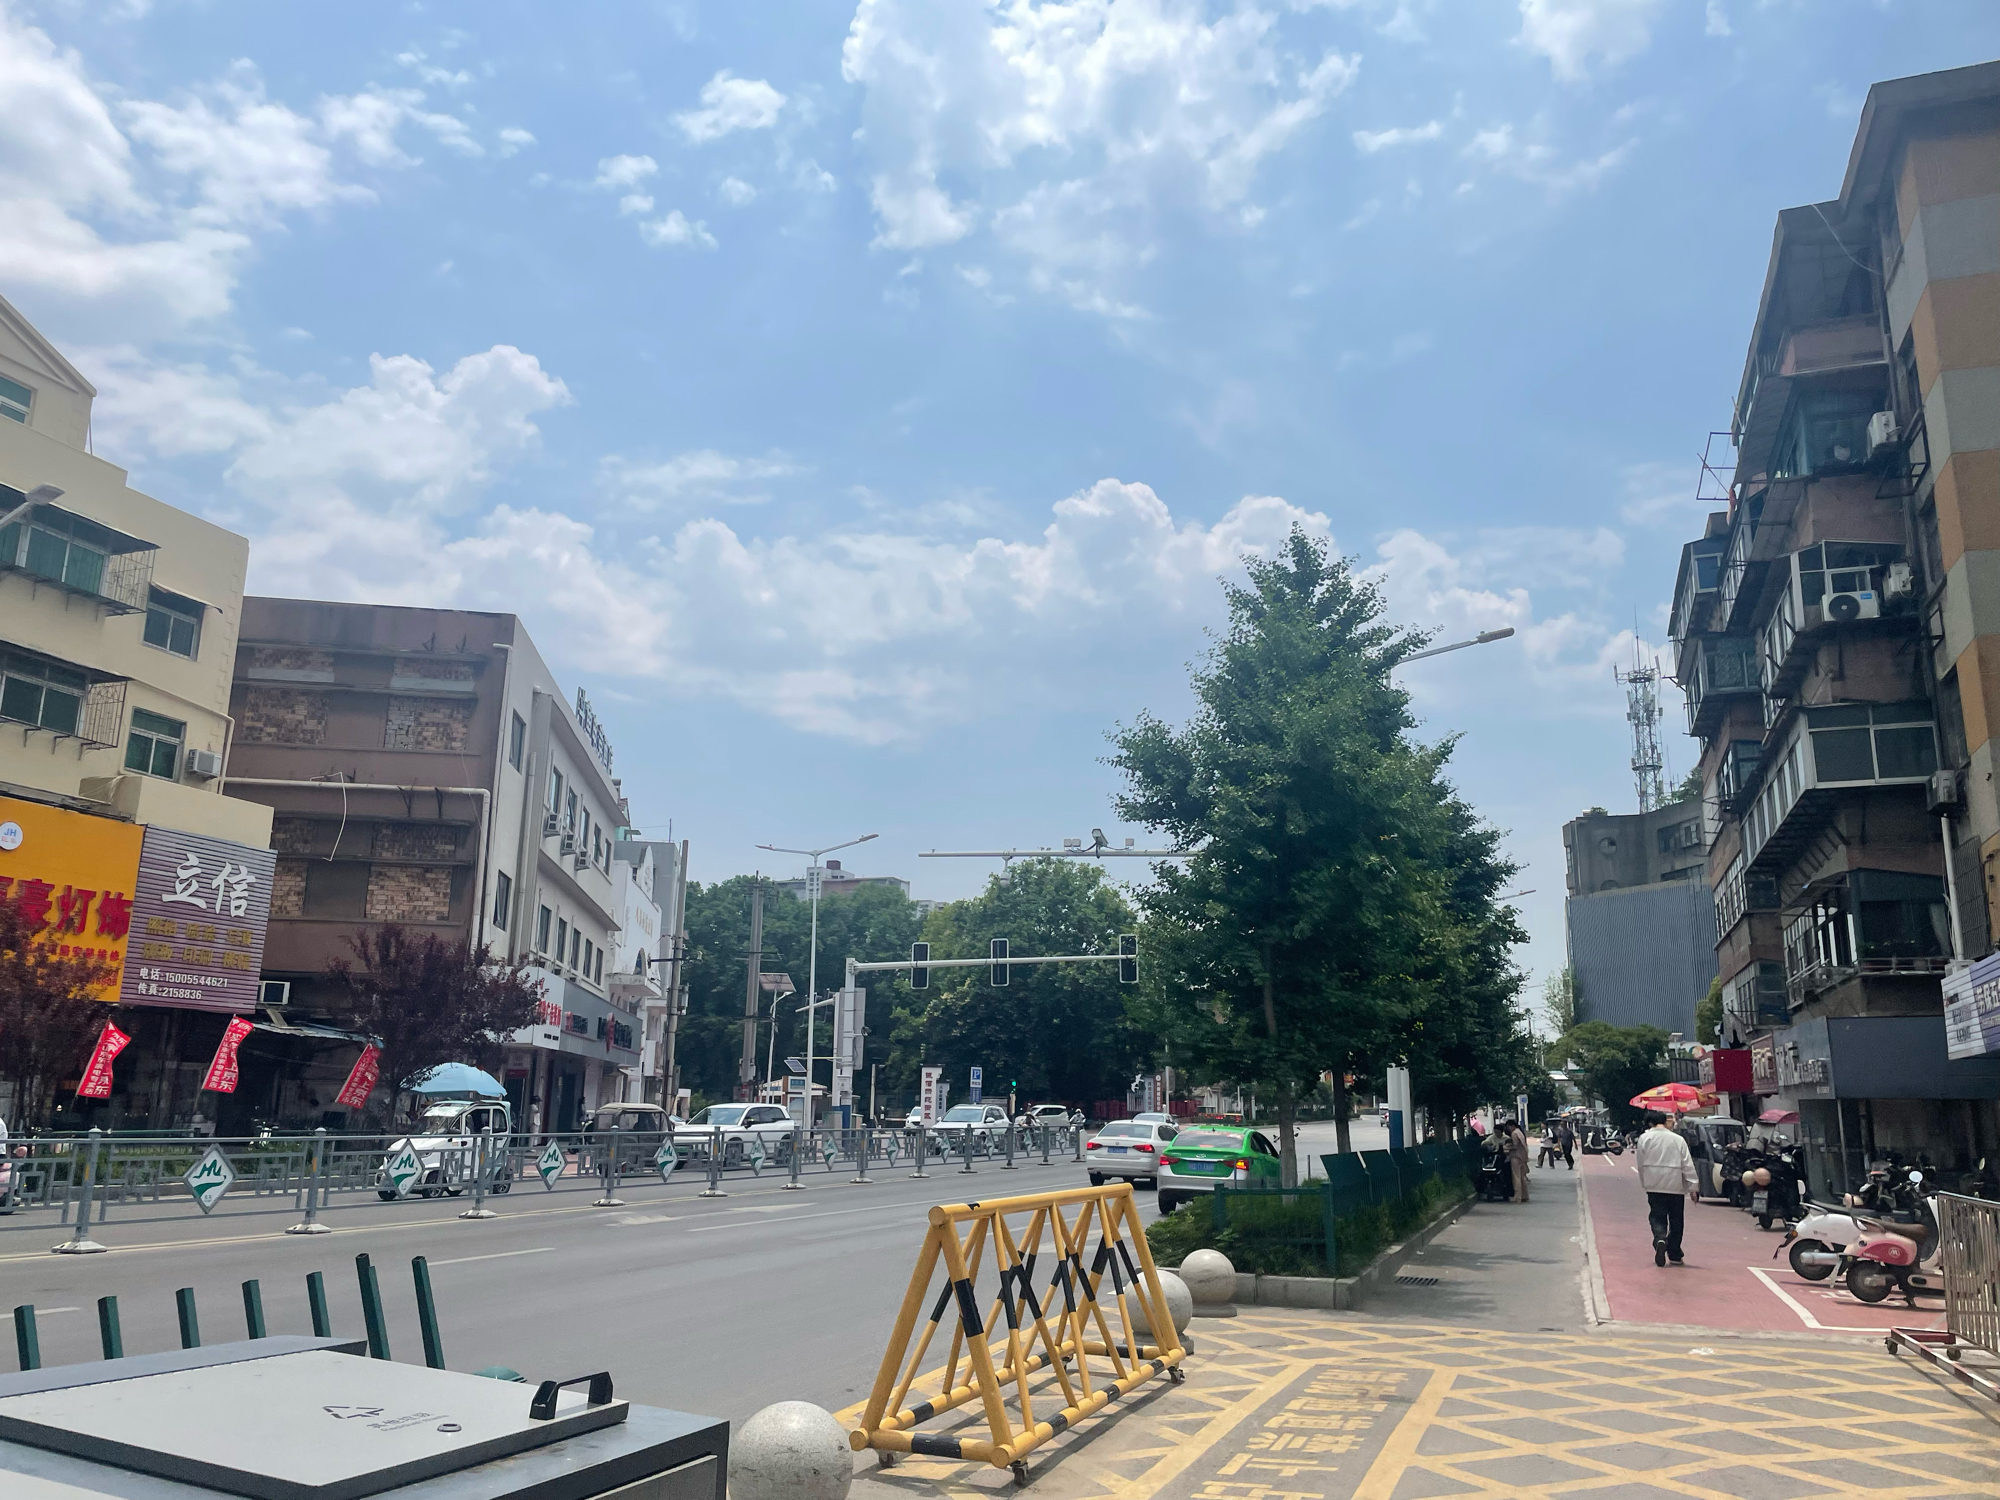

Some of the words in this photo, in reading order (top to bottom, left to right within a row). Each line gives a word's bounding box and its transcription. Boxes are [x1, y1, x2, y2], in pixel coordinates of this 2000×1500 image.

[4, 828, 17, 837] JH
[161, 852, 256, 918] 立信
[0, 875, 134, 941] 豪灯饰
[137, 982, 202, 1001] 传真:2158836
[139, 966, 229, 988] 电话:15005544621
[1975, 977, 2000, 1017] 劳保五
